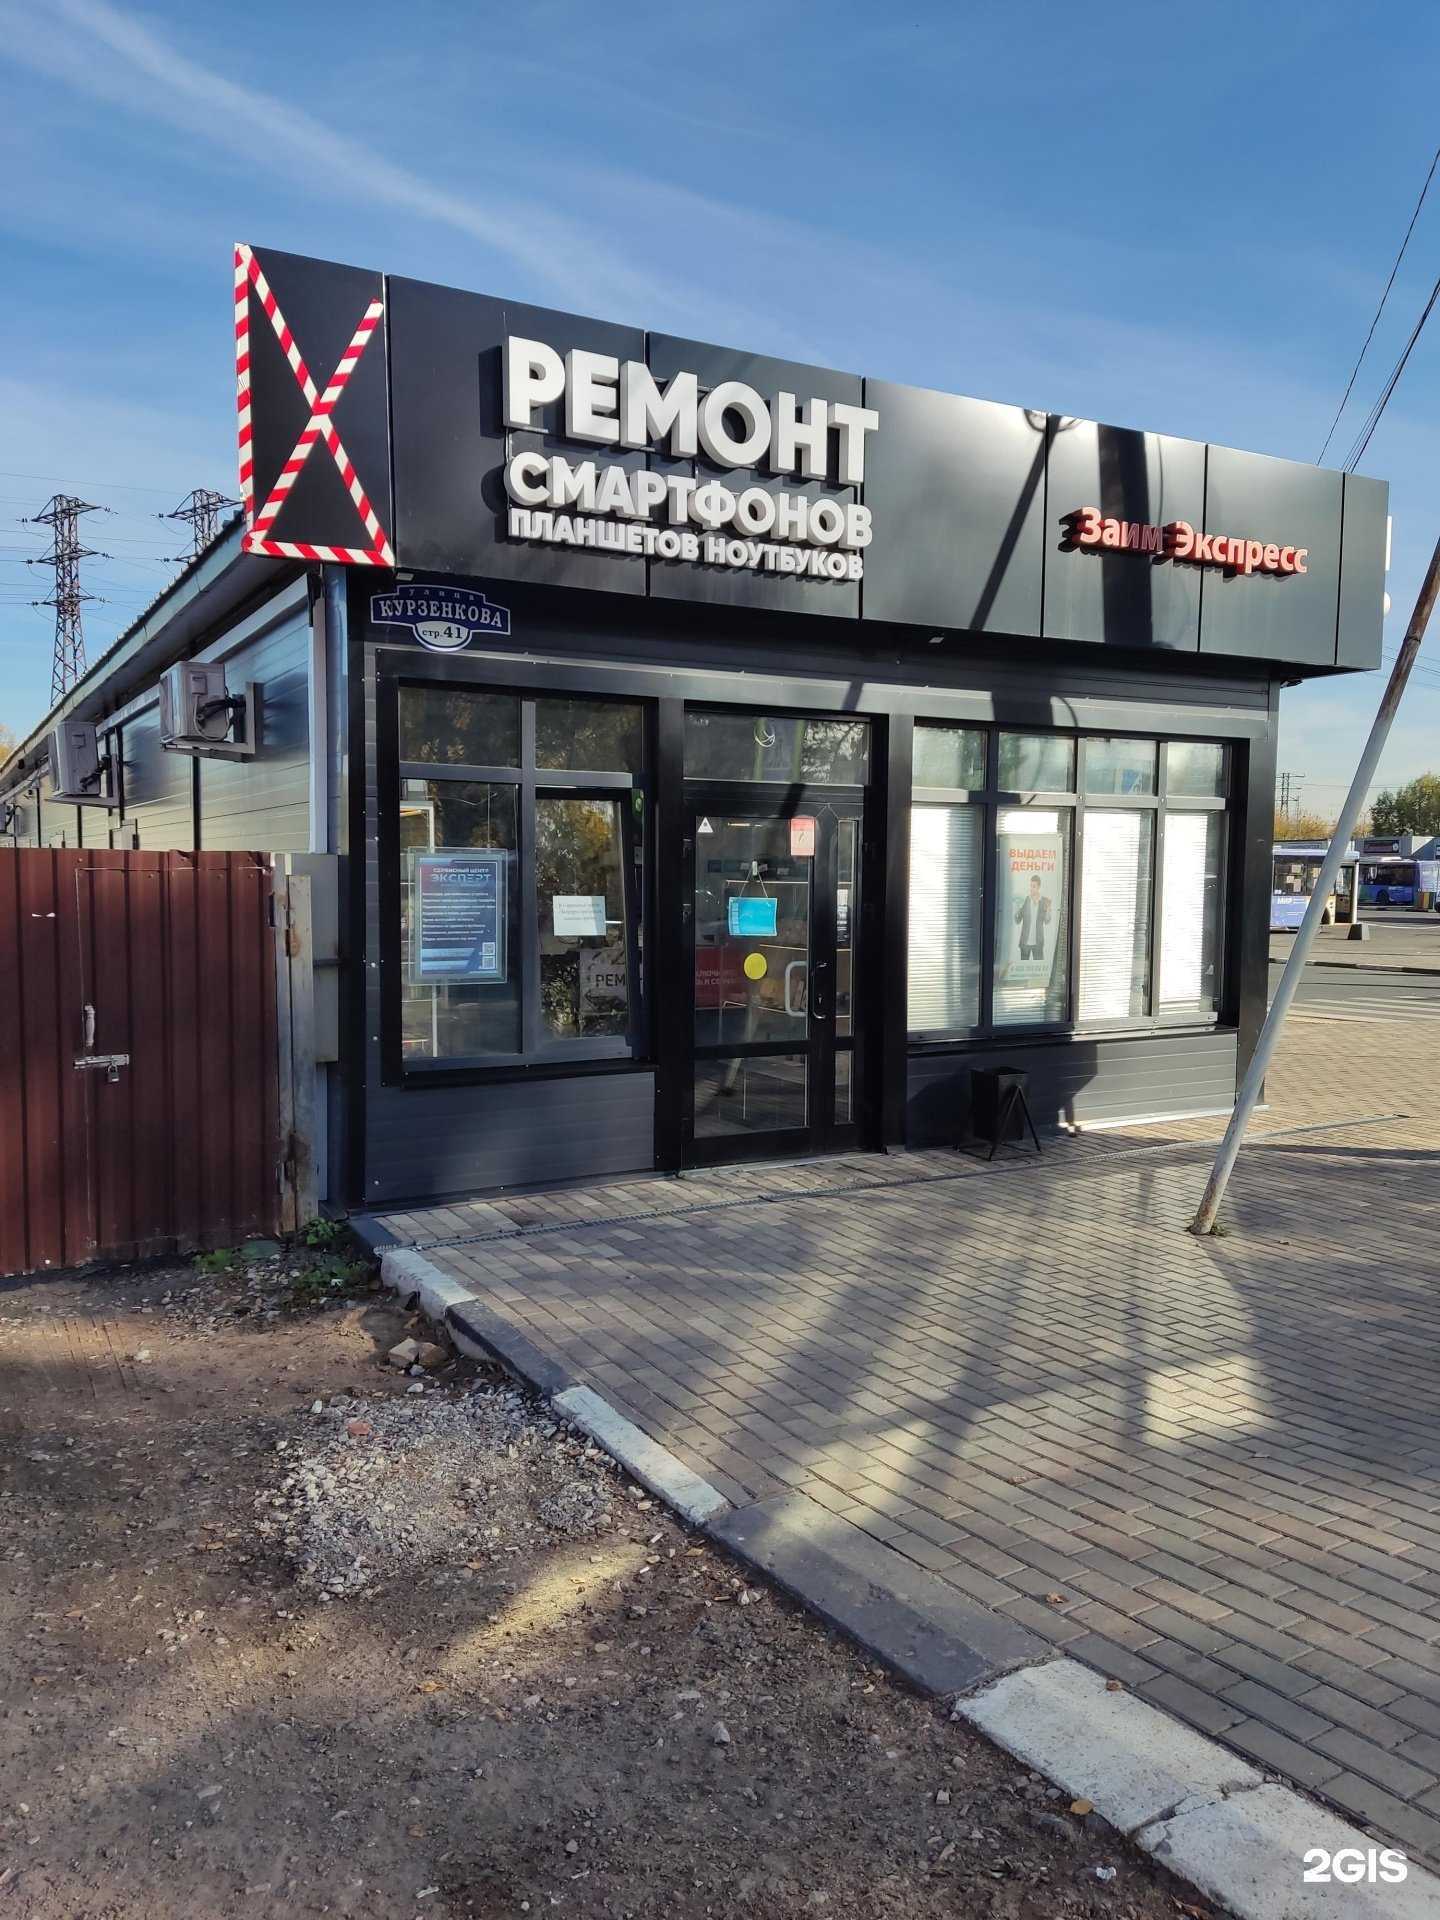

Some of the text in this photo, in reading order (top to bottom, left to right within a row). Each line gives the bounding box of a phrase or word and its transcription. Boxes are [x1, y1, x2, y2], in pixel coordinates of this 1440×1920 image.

[503, 335, 880, 486] РЕМОНТ
[504, 451, 873, 550] СМАРТФОНОВ
[508, 508, 864, 580] ПЛАНШЕТОВ НОУТБУКОВ
[1172, 520, 1308, 574] Экспресс
[378, 599, 503, 628] КУРЗЕНКОВА
[1008, 848, 1058, 860] ВЫДАЕМ
[1010, 860, 1057, 873] ДЕНЬГИ
